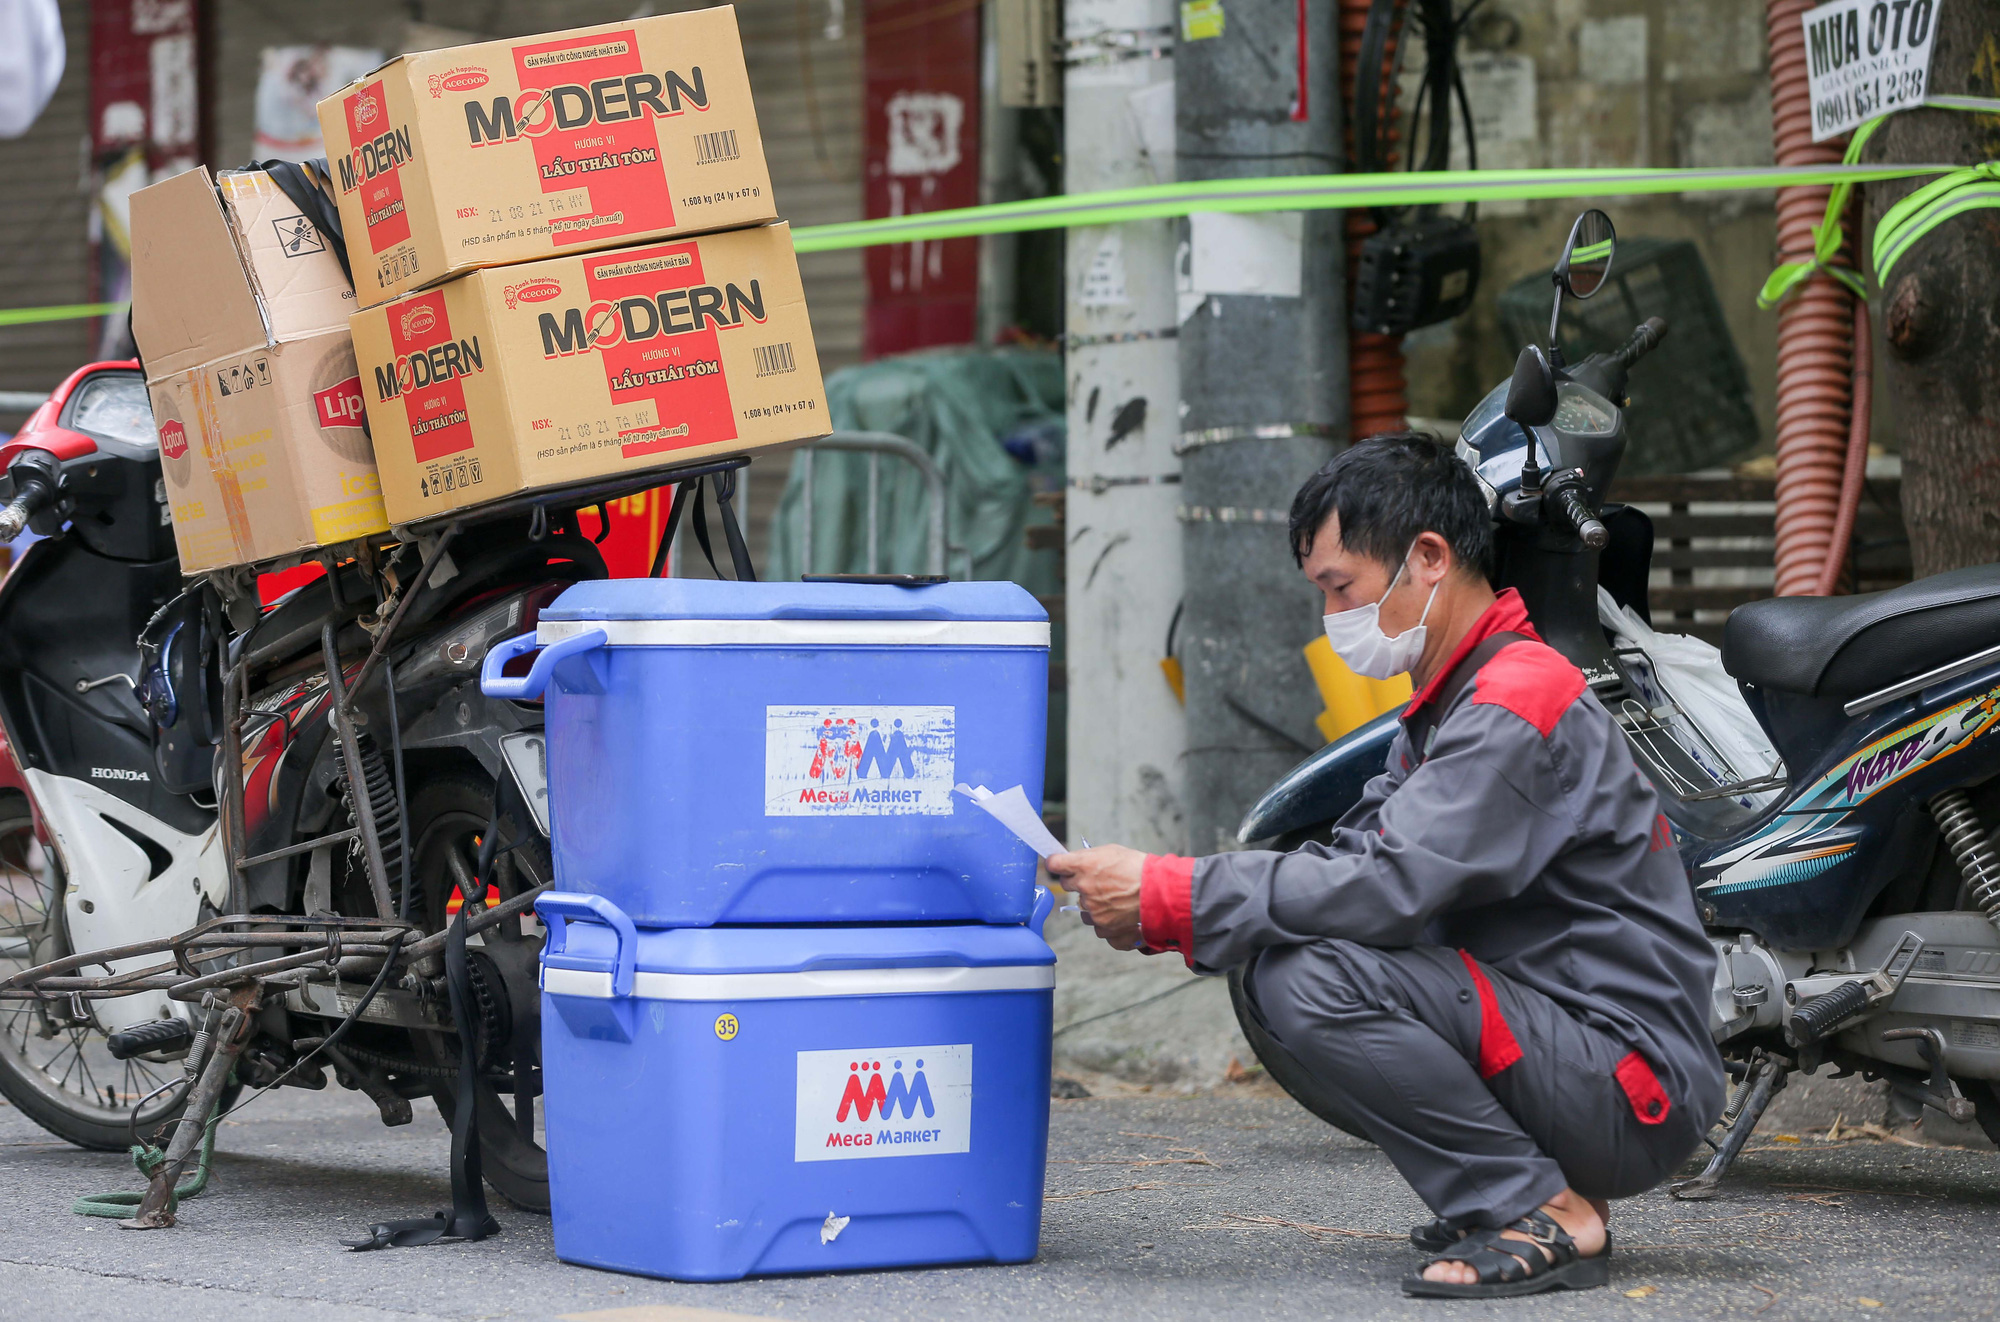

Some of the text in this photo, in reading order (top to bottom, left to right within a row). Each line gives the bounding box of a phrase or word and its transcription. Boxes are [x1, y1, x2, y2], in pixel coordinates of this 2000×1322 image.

[1809, 8, 1860, 78] MUA
[566, 51, 582, 61] CÔNG
[440, 65, 488, 80] Cook happiness
[464, 65, 709, 146] MODERN
[574, 135, 616, 150] HƯƠNG VỊ
[338, 124, 412, 192] MODERN
[541, 147, 657, 179] LẨU THÁI TÔM
[703, 194, 712, 205] kg
[713, 191, 726, 203] (24
[741, 188, 750, 198] 67
[456, 206, 479, 219] NSX:
[488, 208, 503, 223] 21
[529, 201, 544, 216] 21
[461, 212, 624, 248] (HSD sản phẩm là 5 tháng kể từ ngày sản xuất)
[633, 262, 649, 273] CÔNG
[515, 277, 560, 291] Cook happiness
[538, 278, 767, 355] MODERN
[641, 346, 681, 362] HƯƠNG VỊ
[374, 335, 484, 401] MODERN
[611, 359, 719, 391] LẨU THÁI TÔM
[244, 377, 254, 390] UP
[763, 407, 771, 417] kg
[772, 405, 784, 415] (24
[798, 400, 806, 409] 67
[429, 413, 449, 431] THÁI
[448, 409, 467, 424] TÔM
[531, 418, 553, 431] NSX:
[558, 426, 571, 441] 21
[595, 419, 610, 434] 21
[161, 430, 185, 452] Lipton
[536, 424, 689, 460] (HSD sản phẩm là 5 tháng kể từ ngày sản xuất)
[91, 767, 150, 782] HONDA
[718, 1018, 736, 1035] 35
